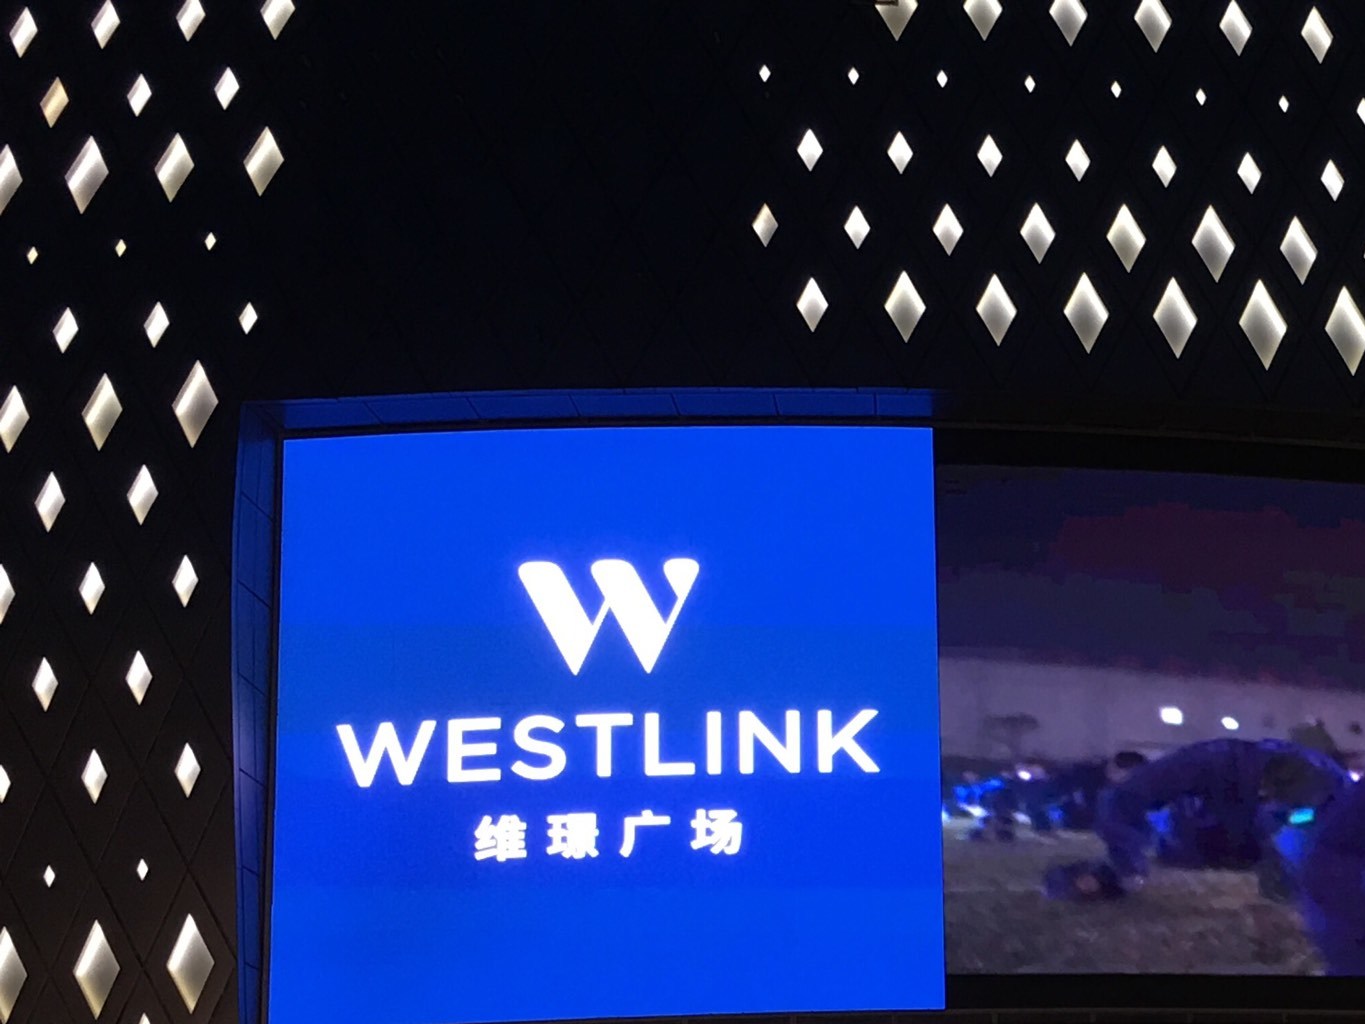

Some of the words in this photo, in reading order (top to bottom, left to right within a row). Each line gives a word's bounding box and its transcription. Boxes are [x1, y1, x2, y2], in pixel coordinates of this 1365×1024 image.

[518, 558, 699, 675] W
[336, 709, 880, 787] WESTLINK
[474, 808, 742, 862] 维璟广场
